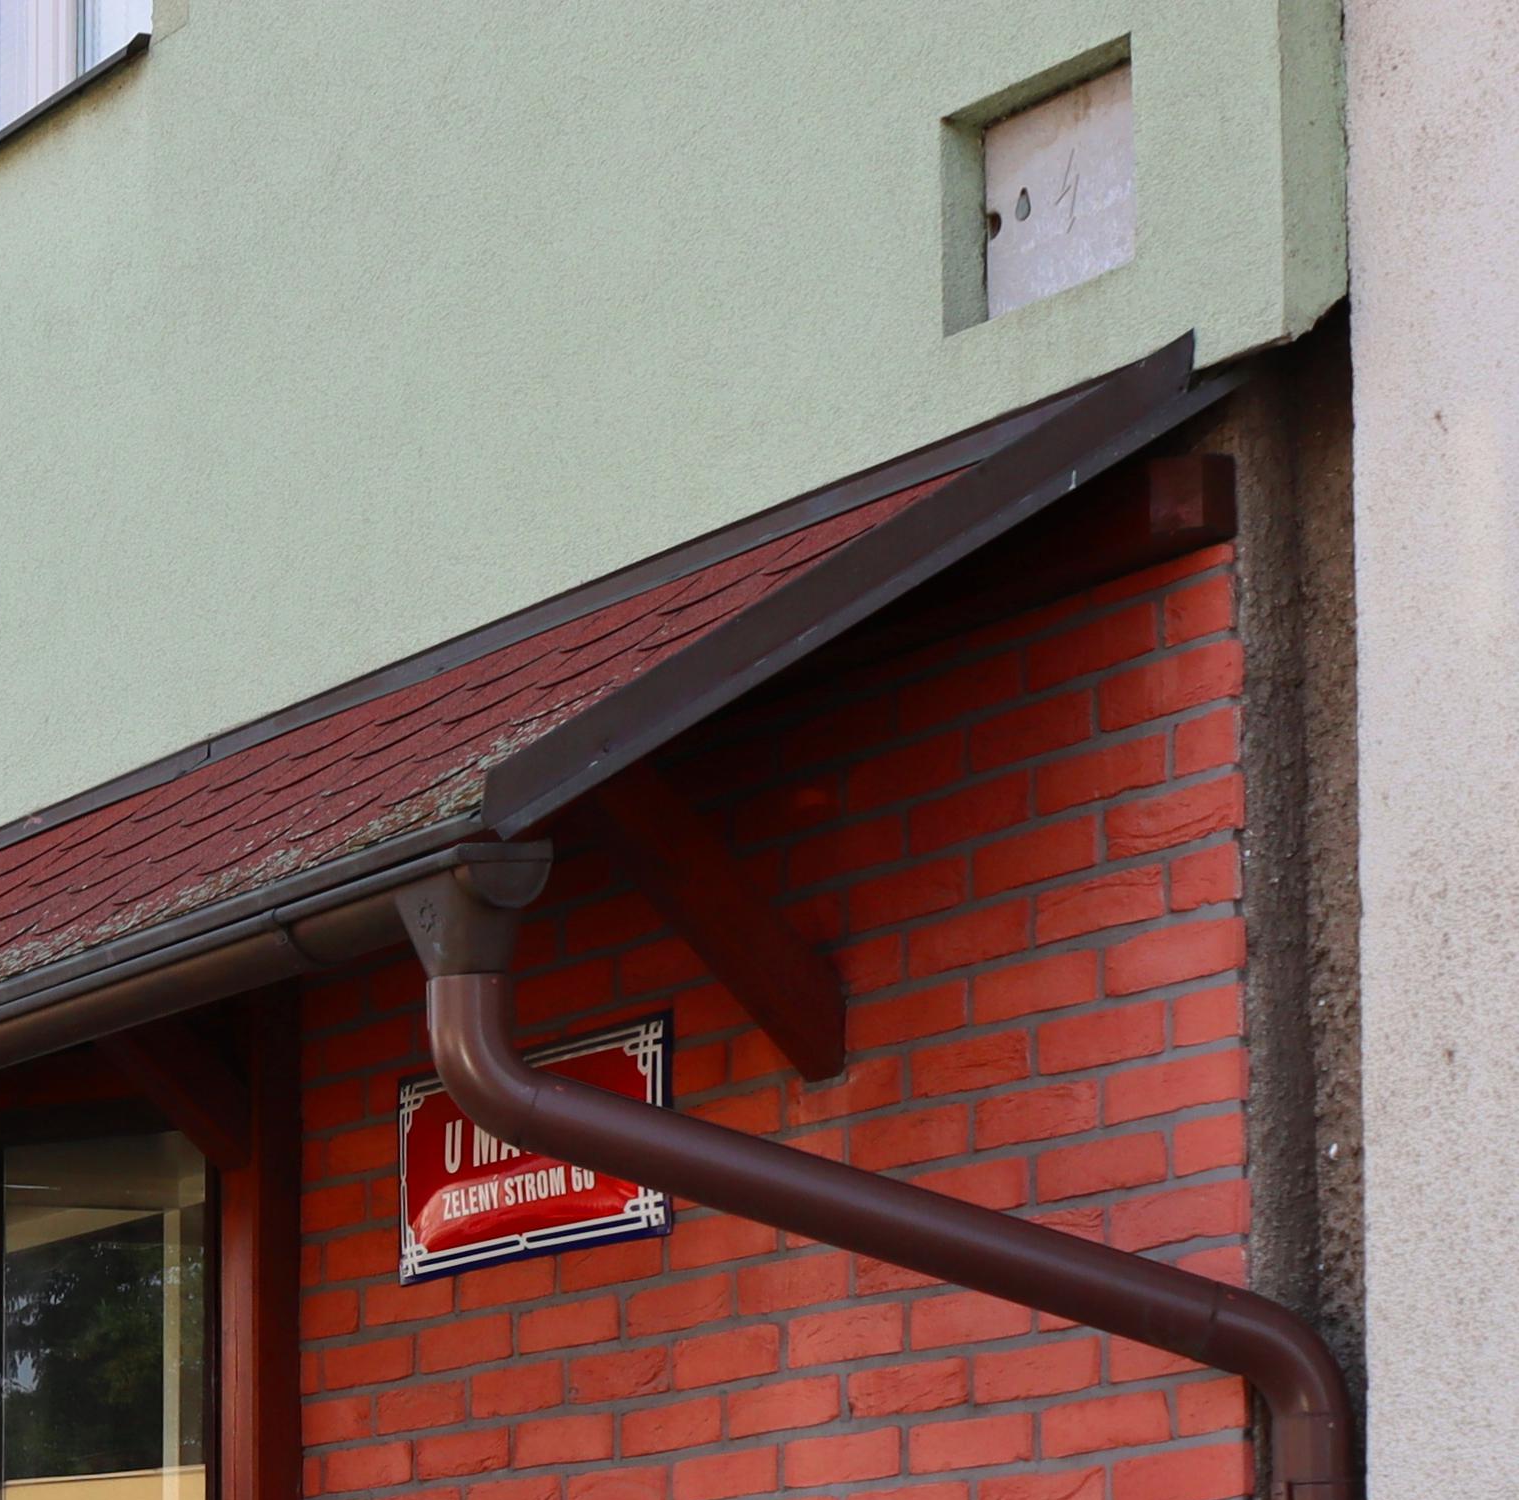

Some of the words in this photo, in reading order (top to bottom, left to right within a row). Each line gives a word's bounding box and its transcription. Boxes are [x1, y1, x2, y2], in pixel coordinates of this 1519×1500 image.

[445, 1119, 462, 1174] U
[442, 1174, 499, 1221] ZELENÝ
[504, 1166, 567, 1207] STROM
